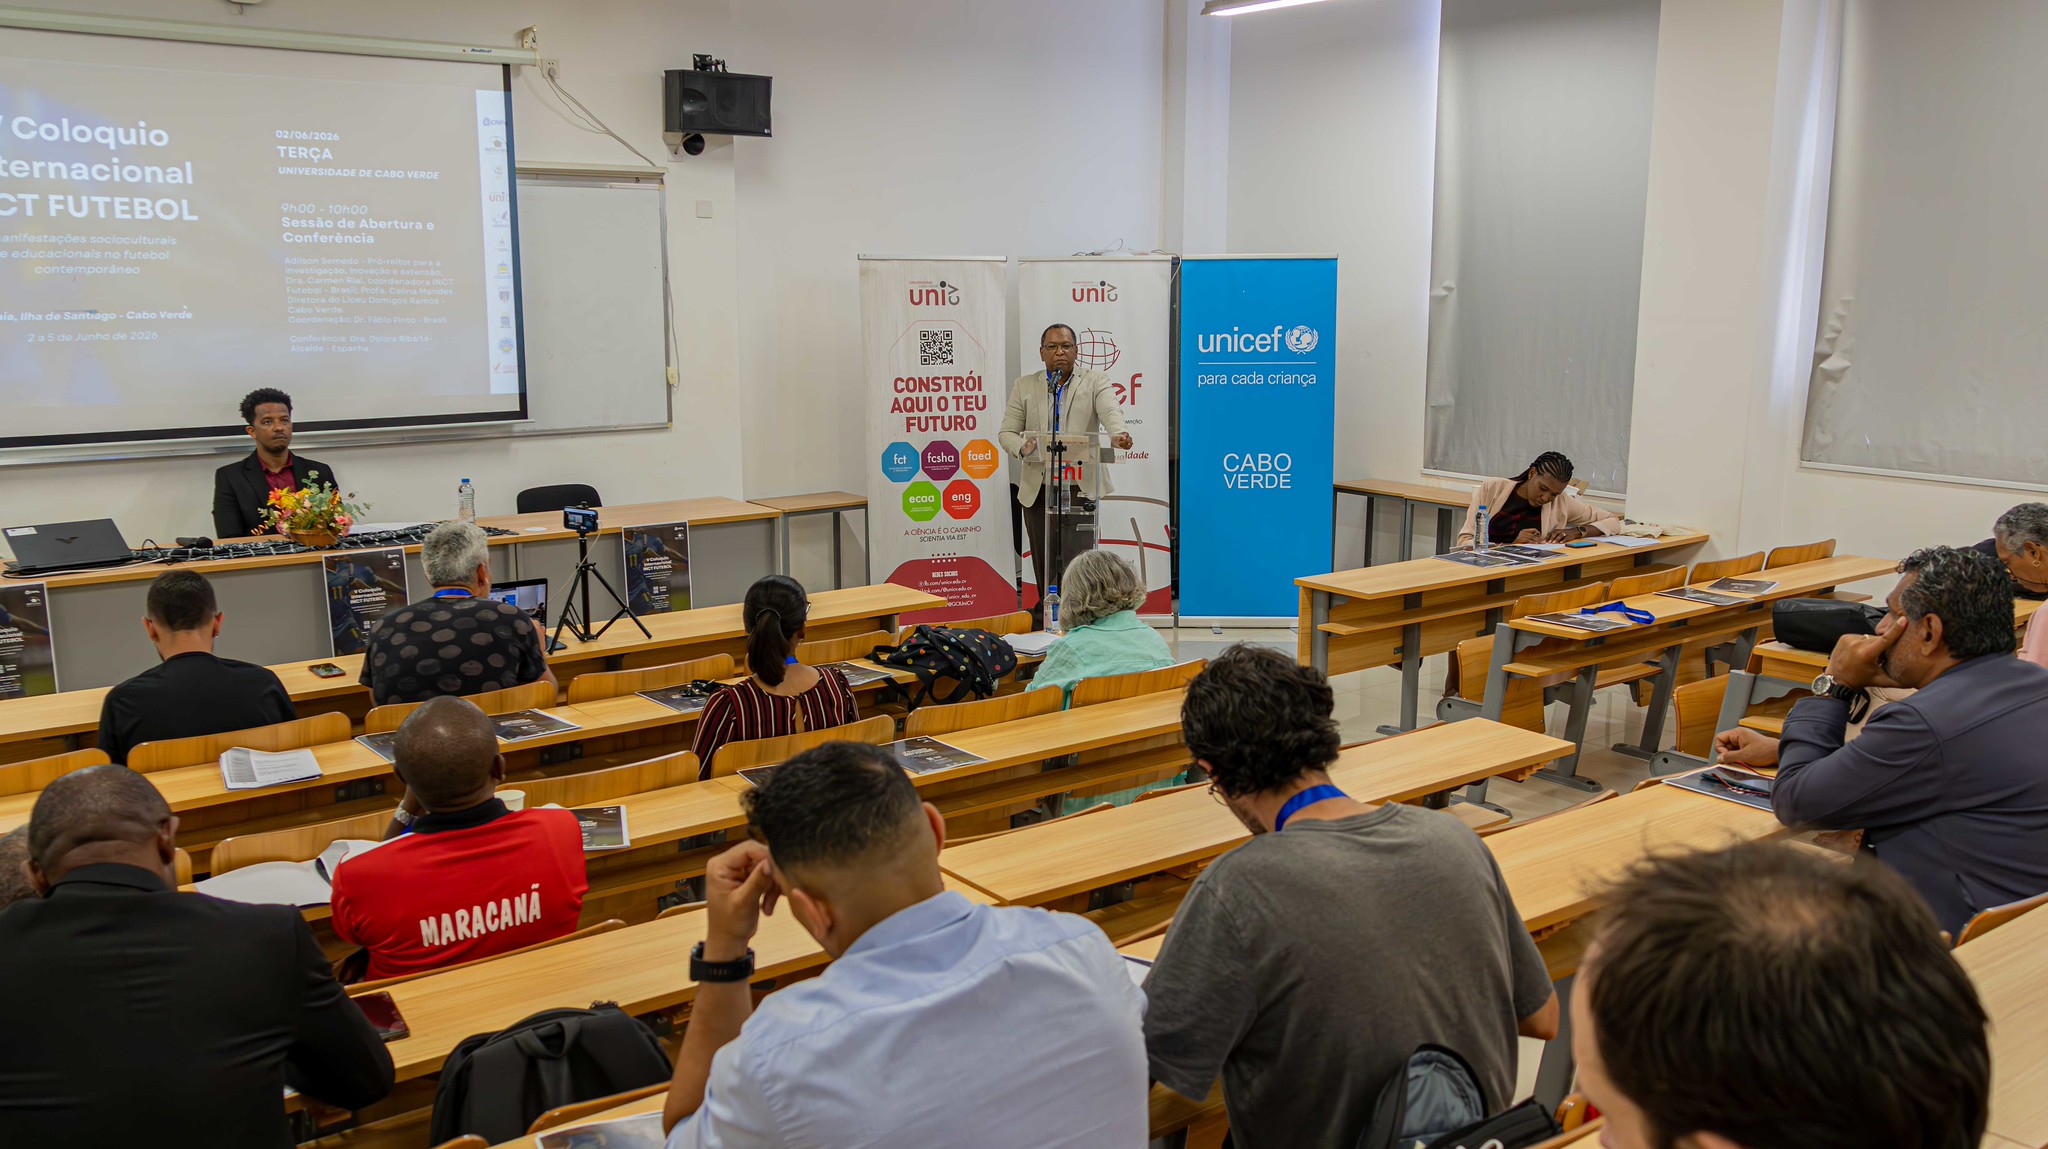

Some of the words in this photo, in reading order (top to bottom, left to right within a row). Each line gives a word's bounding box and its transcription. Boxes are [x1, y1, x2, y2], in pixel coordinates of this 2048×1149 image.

[11, 116, 169, 150] Coloquio
[275, 130, 340, 141] 02/06/2026
[277, 146, 333, 163] TERÇA
[278, 166, 356, 177] UNIVERSIDADE
[359, 169, 372, 177] DE
[375, 170, 404, 179] CABO
[407, 171, 439, 180] VERDE
[48, 194, 199, 221] FUTEBOL
[281, 203, 316, 214] 9h00
[328, 205, 368, 215] 10h00
[281, 217, 334, 229] Sessão
[337, 218, 355, 229] de
[359, 219, 423, 230] Abertura
[426, 222, 434, 230] e
[0, 233, 86, 245] anifestações
[90, 235, 177, 246] socioculturais
[283, 232, 375, 244] Conferência
[12, 249, 101, 259] educacionais
[104, 251, 121, 259] no
[124, 250, 169, 260] futebol
[34, 265, 141, 275] contemporâneo
[909, 281, 946, 306] uni
[1072, 281, 1106, 302] uni
[21, 312, 43, 321] Ilha
[45, 312, 61, 321] de
[64, 311, 116, 322] Santiago
[126, 311, 157, 320] Cabo
[27, 333, 35, 342] 2
[48, 333, 54, 342] 5
[57, 333, 72, 342] de
[74, 331, 110, 342] Junho
[112, 331, 127, 341] de
[129, 331, 158, 341] 2026
[1198, 325, 1282, 354] unicef
[893, 370, 982, 393] CONSTRÓI
[1198, 373, 1227, 388] para
[1231, 371, 1264, 385] cada
[1268, 371, 1317, 388] criança
[891, 396, 933, 414] AQUI
[936, 396, 949, 412] O
[952, 395, 987, 412] TEU
[905, 414, 977, 433] FUTURO
[894, 454, 907, 465] fct
[927, 452, 955, 463] fcsha
[968, 450, 992, 461] faed
[1223, 453, 1292, 473] CABO
[1223, 474, 1292, 489] VERDE
[909, 494, 935, 503] ecaa
[952, 493, 971, 503] eng
[911, 528, 937, 536] CIÊNCIA
[950, 525, 982, 534] CAMINHO
[419, 883, 541, 947] MARACANÃ
